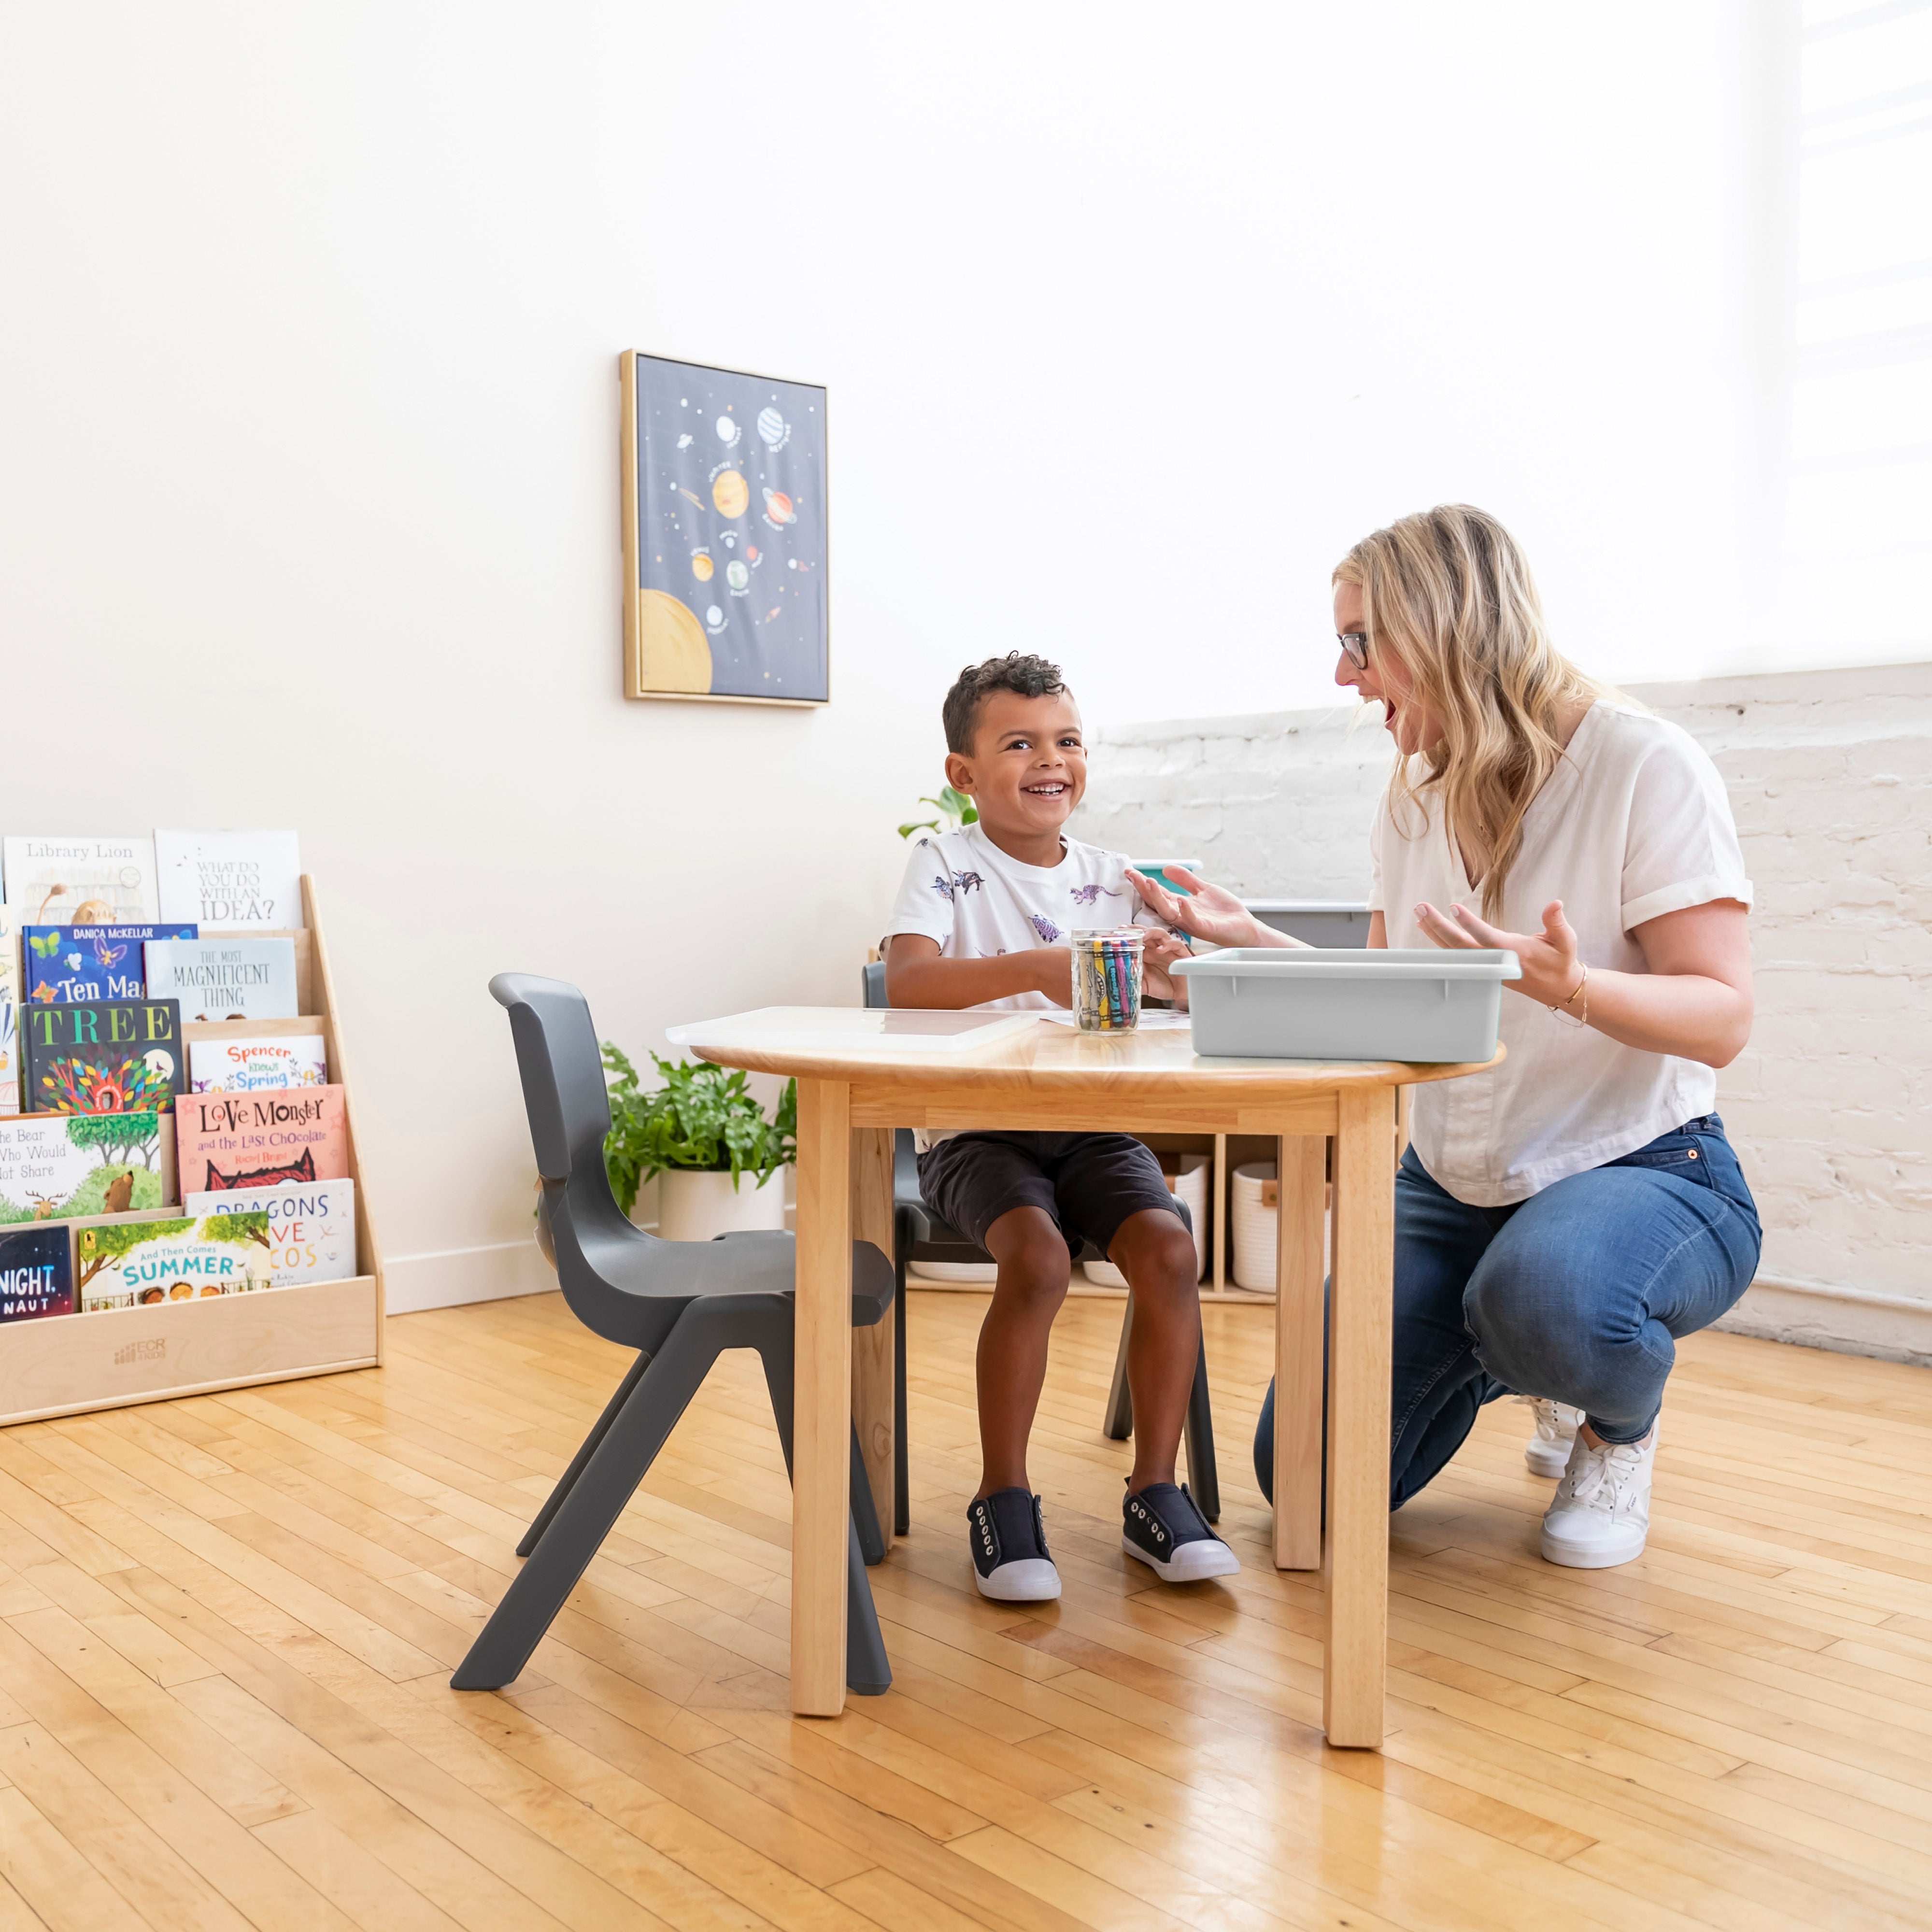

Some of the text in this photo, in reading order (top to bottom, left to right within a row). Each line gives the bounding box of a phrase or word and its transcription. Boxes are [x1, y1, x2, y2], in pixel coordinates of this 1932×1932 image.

[27, 843, 133, 861] Library Lion
[197, 862, 259, 872] WHAT DO
[199, 874, 260, 886] YOU DO
[199, 887, 260, 899] WITH AN
[200, 899, 274, 921] IDEA?
[73, 927, 153, 939] DANICA McKELLAR
[200, 951, 242, 964] THE MOST
[174, 963, 270, 987] MAGNIFICENT
[57, 975, 145, 1003] Ten Ma
[201, 988, 244, 1008] THING
[33, 1006, 172, 1046] TREE
[227, 1046, 291, 1063] Spencer
[236, 1071, 288, 1090] Spring
[17, 1129, 45, 1142] Bear
[26, 1144, 66, 1159] Would
[198, 1139, 215, 1151] and
[219, 1137, 237, 1150] the
[0, 1165, 54, 1179] ot Share
[141, 1245, 216, 1261] And Then Comes
[123, 1256, 233, 1287] SUMMER
[137, 1338, 165, 1353] ECR
